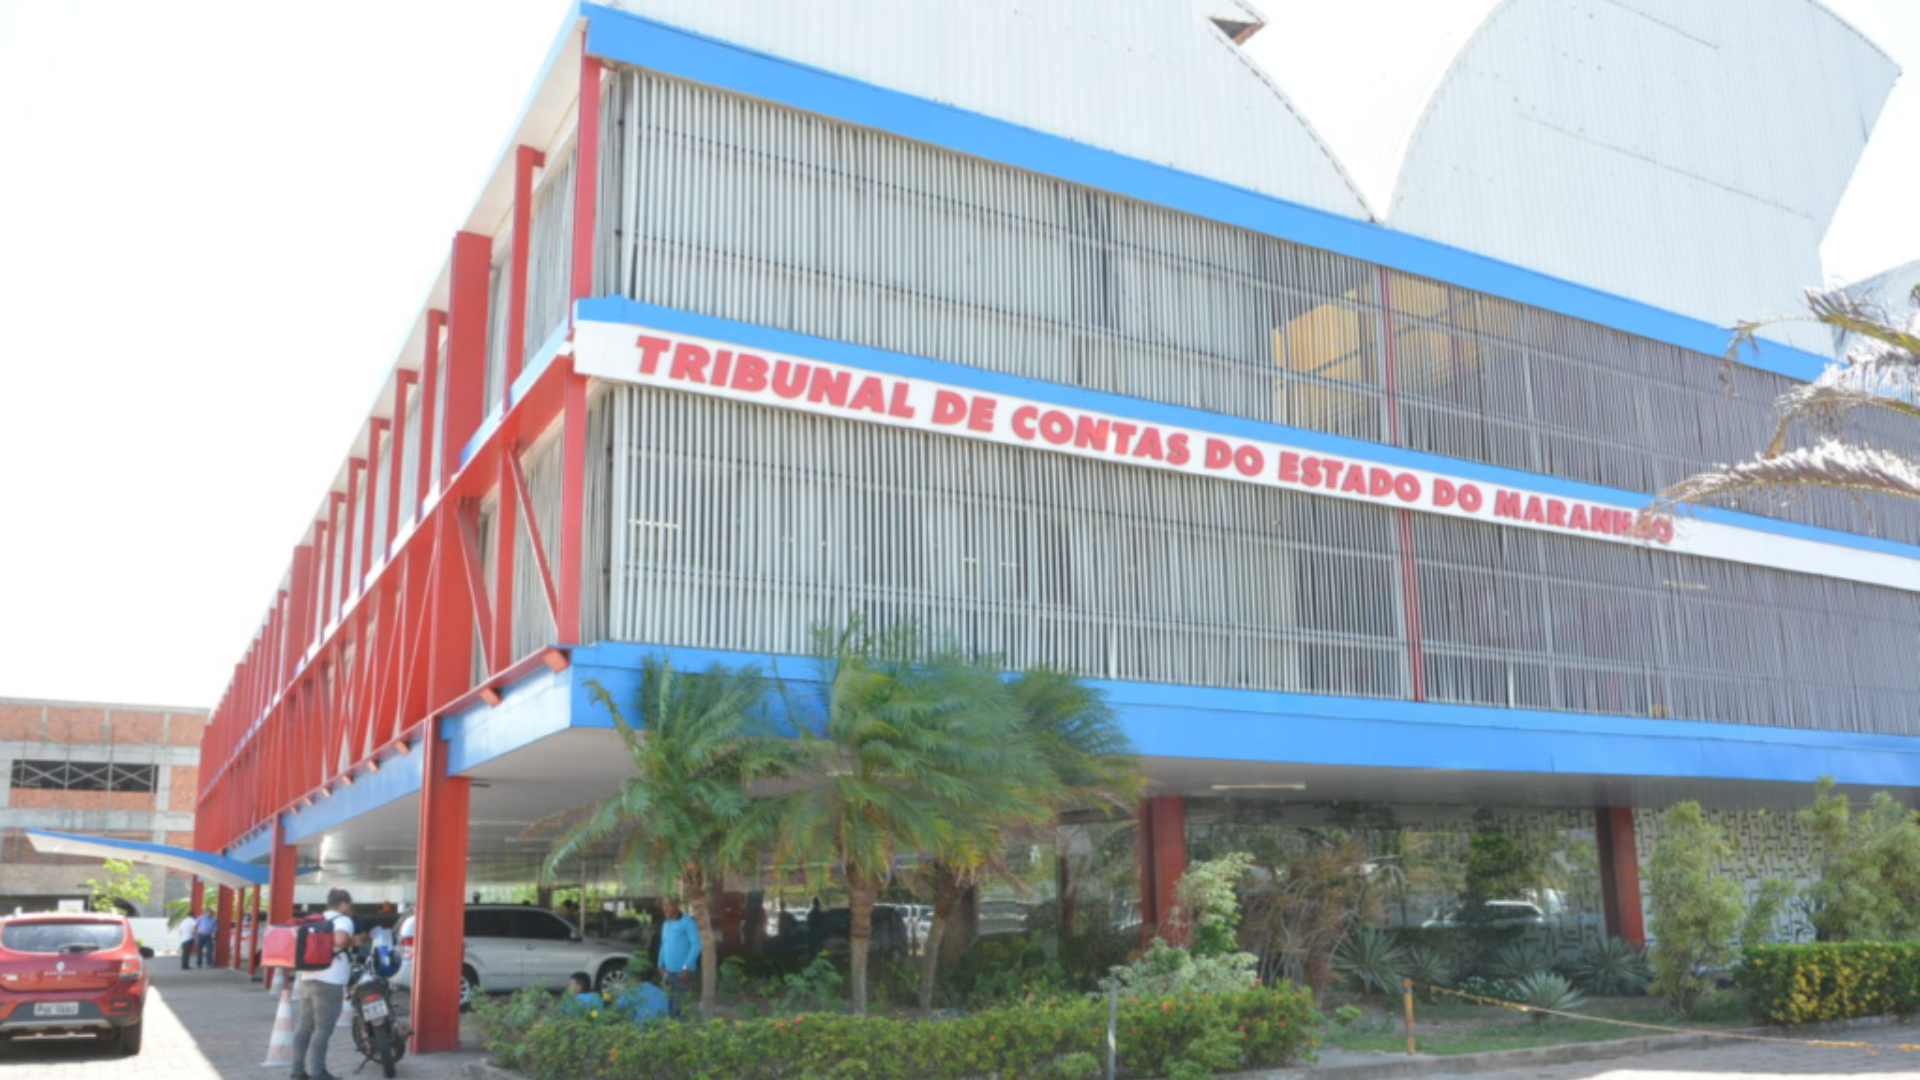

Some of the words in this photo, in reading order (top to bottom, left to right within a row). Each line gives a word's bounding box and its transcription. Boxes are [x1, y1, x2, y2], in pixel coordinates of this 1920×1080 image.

[637, 336, 916, 415] TRIBUNAL
[934, 390, 998, 431] DE
[1013, 405, 1191, 466] CONTAS
[1206, 438, 1265, 476] DO
[1280, 452, 1421, 502] ESTADO
[1434, 478, 1483, 512] DO
